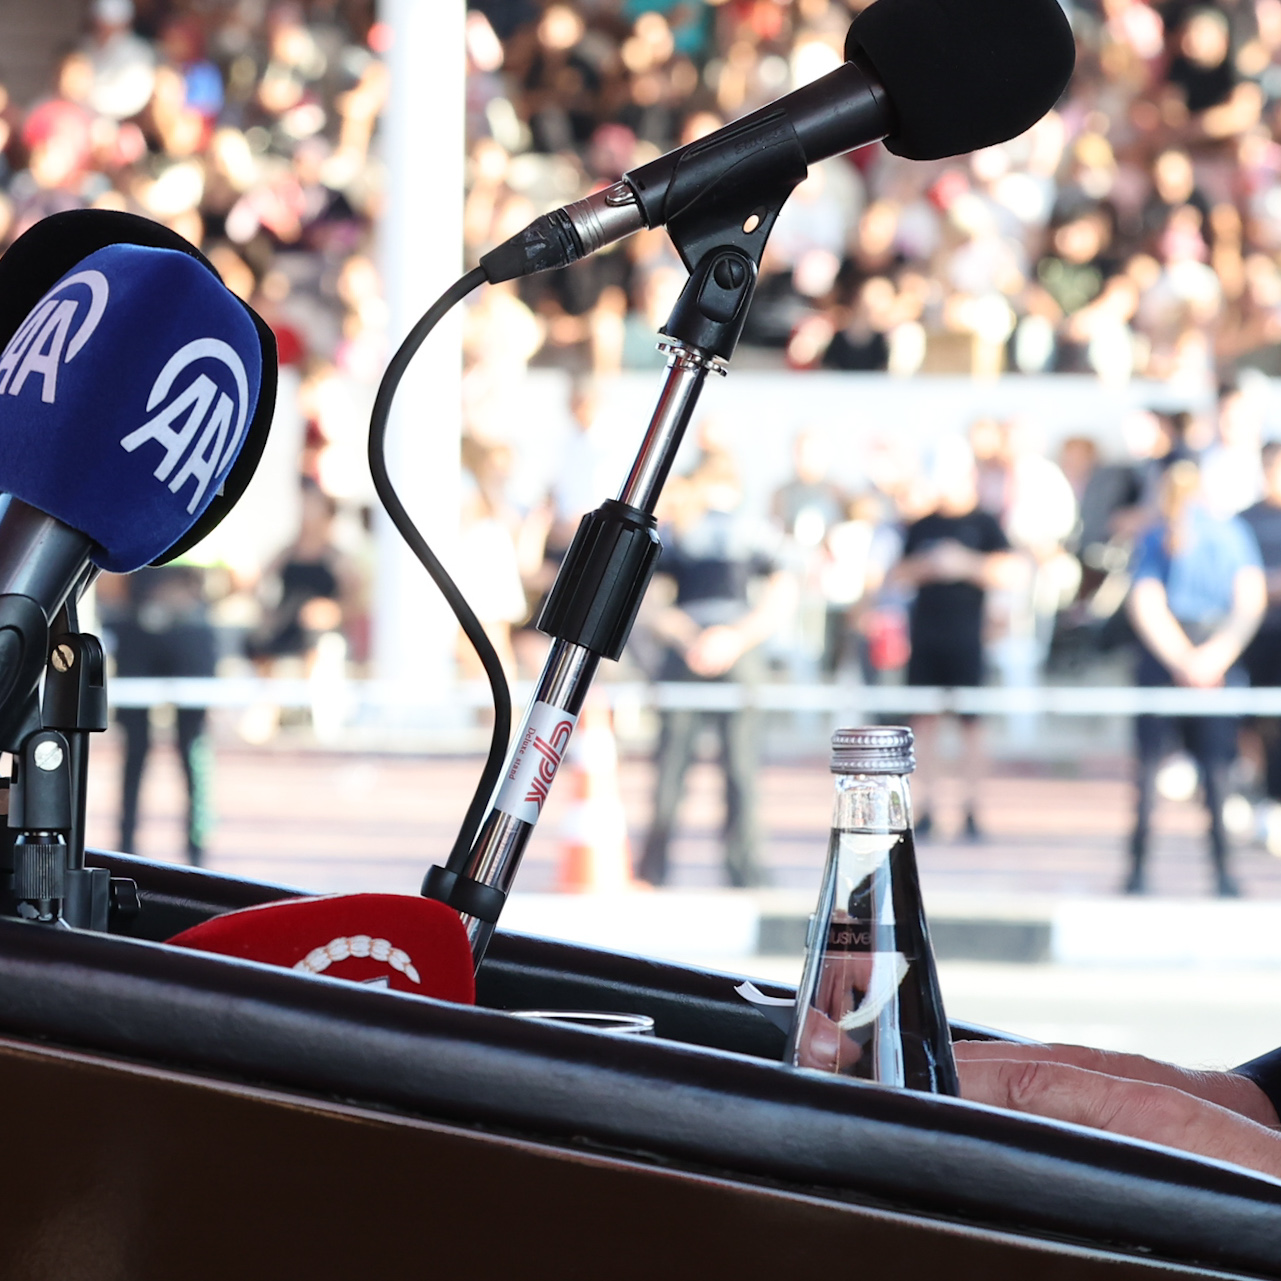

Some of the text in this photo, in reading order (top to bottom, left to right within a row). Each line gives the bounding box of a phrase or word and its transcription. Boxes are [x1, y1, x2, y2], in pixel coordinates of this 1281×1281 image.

[120, 373, 234, 515] AA
[508, 726, 536, 780] Deluxe stand
